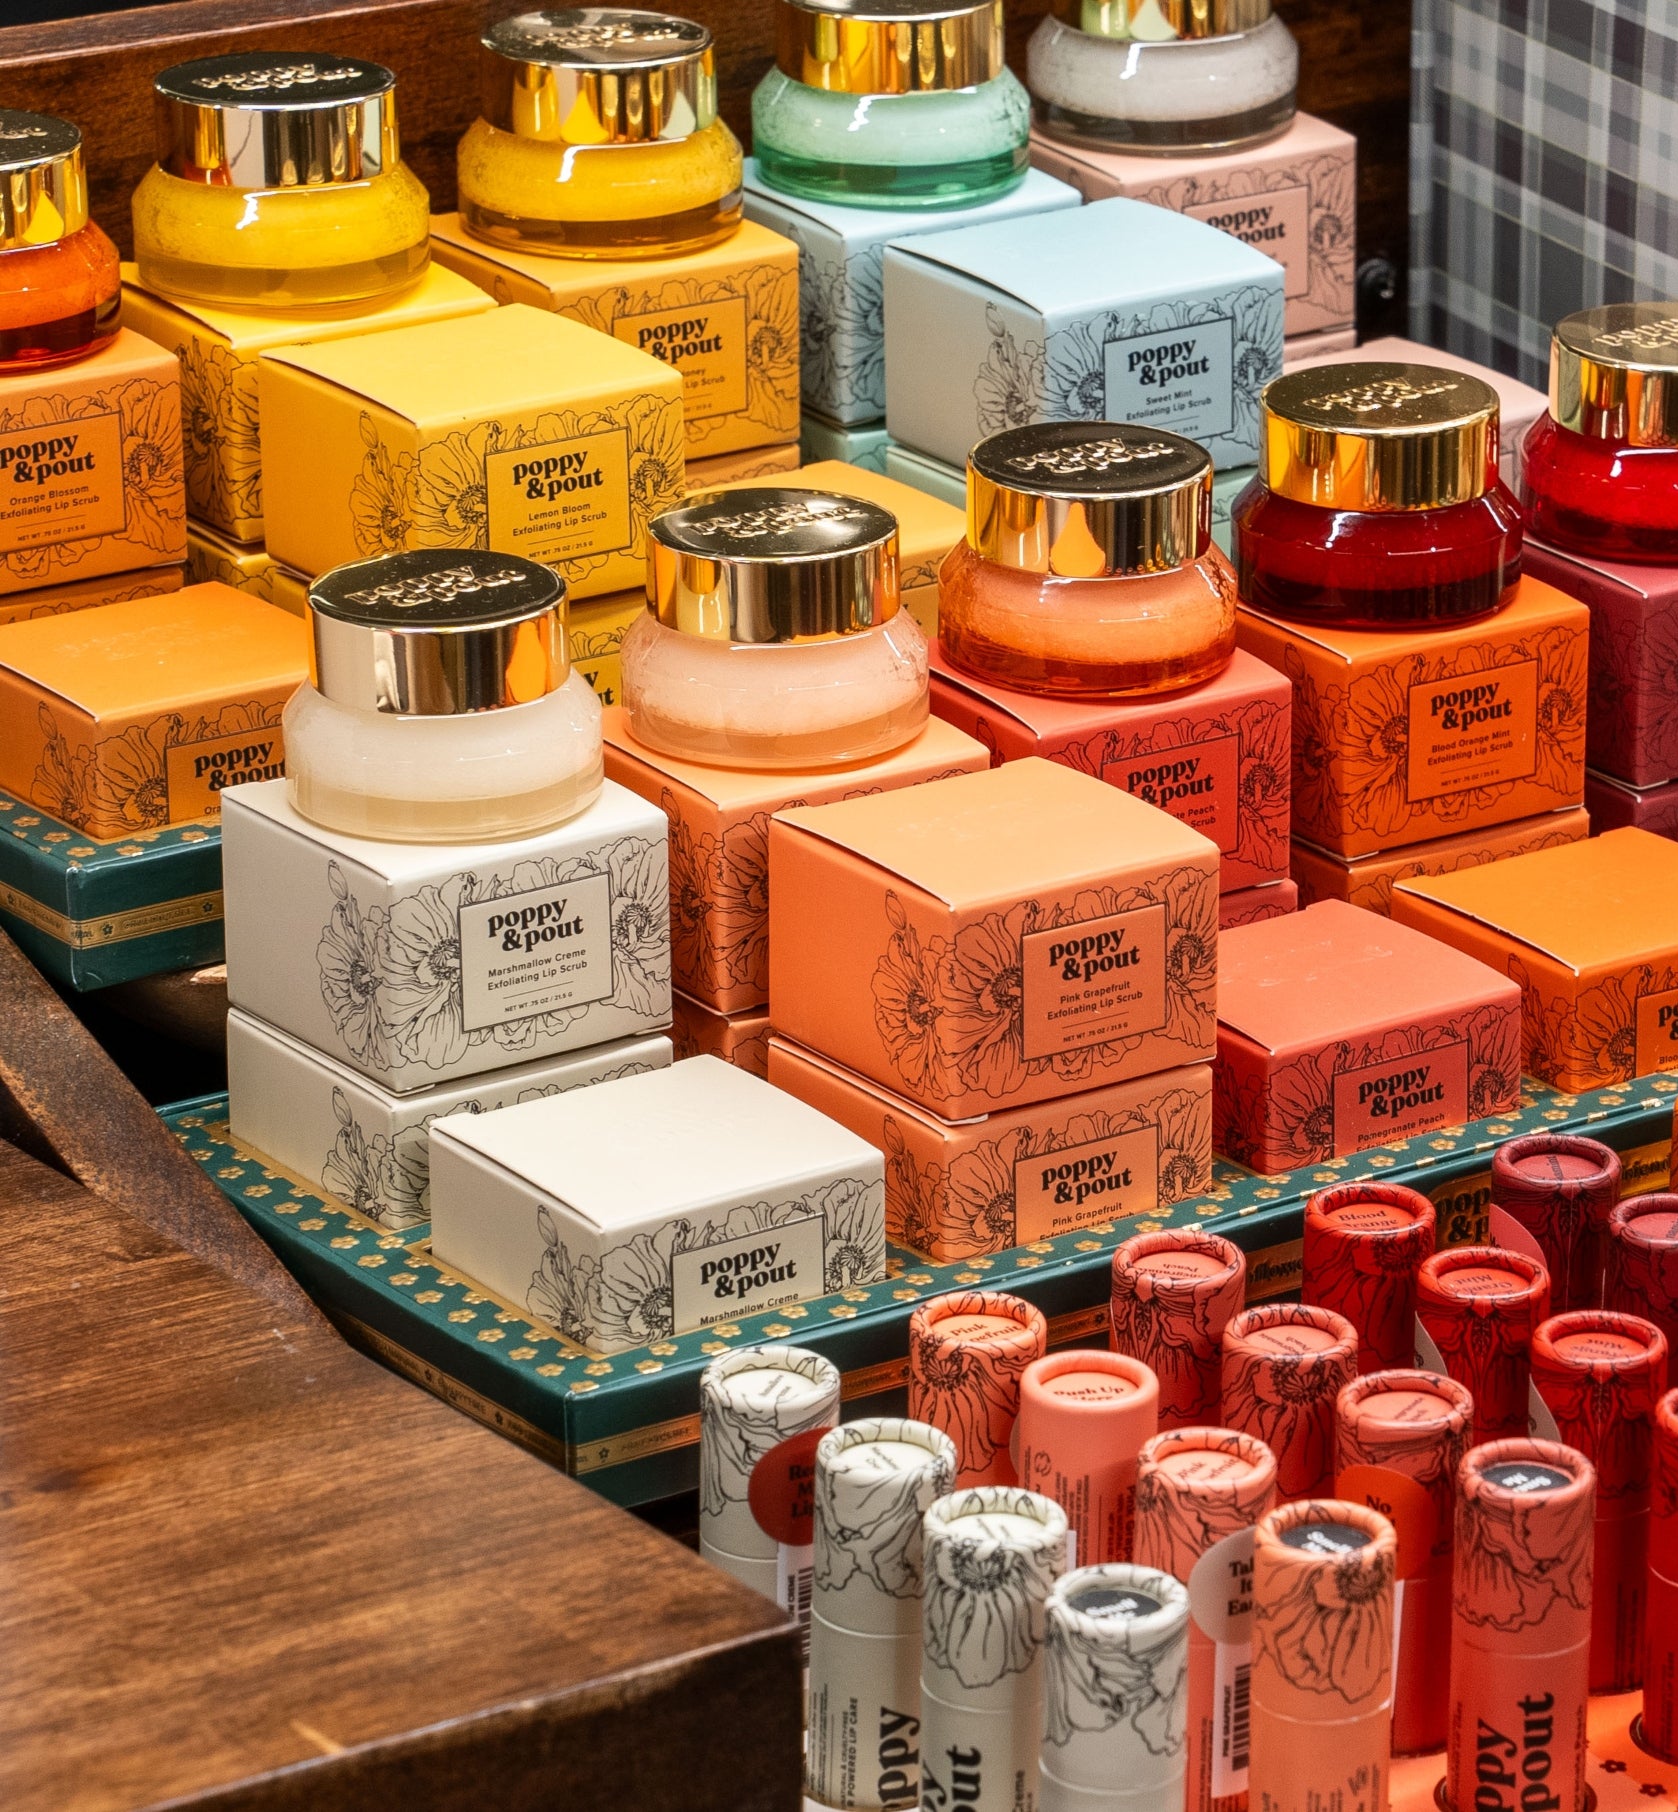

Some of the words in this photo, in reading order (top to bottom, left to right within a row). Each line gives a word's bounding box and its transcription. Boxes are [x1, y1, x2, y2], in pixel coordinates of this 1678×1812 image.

[638, 317, 708, 349] poppy
[1128, 339, 1196, 372] poppy
[1126, 405, 1171, 421] Exfoliating
[1173, 402, 1186, 413] Lip
[1187, 397, 1212, 409] Scrub
[1146, 393, 1173, 406] Sweet
[1174, 389, 1193, 401] Mint
[0, 435, 79, 469] poppy
[512, 451, 588, 485] poppy
[0, 504, 52, 520] Exfoliating
[55, 501, 70, 511] Lip
[72, 495, 100, 507] Scrub
[10, 494, 46, 506] Orange
[49, 485, 89, 498] Blossom
[512, 520, 562, 537] Exfoliating
[565, 516, 579, 528] Lip
[581, 511, 608, 523] Scrub
[528, 509, 559, 522] Lemon
[562, 503, 591, 515] Bloom
[1431, 682, 1500, 717] poppy
[1427, 750, 1473, 766] Exfoliating
[1474, 746, 1488, 756] Lip
[1490, 740, 1514, 752] Scrub
[1432, 741, 1457, 753] Blood
[1458, 734, 1490, 748] Orange
[1492, 730, 1510, 740] Mint
[194, 741, 274, 778] poppy
[1127, 757, 1201, 793] poppy
[1188, 805, 1215, 817] Peach
[1190, 816, 1216, 828] Scrub
[487, 898, 568, 939] poppy
[1048, 928, 1126, 967] poppy
[487, 972, 540, 991] Exfoliating
[542, 967, 557, 978] Lip
[560, 960, 588, 973] Scrub
[488, 957, 552, 978] Marshmallow
[554, 948, 587, 962] Creme
[1047, 1004, 1097, 1021] Exfoliating
[1099, 998, 1114, 1009] Lip
[1117, 991, 1143, 1004] Scrub
[1060, 993, 1080, 1004] Pink
[1083, 981, 1130, 999] Grapefruit
[1358, 1065, 1431, 1104] poppy
[1357, 1121, 1416, 1143] Pomegranate
[1418, 1113, 1445, 1127] Peach
[1041, 1151, 1118, 1191] poppy
[1052, 1215, 1072, 1227] Pink
[1075, 1202, 1122, 1221] Grapefruit
[1338, 1209, 1387, 1222] Blood
[700, 1243, 781, 1285] poppy
[700, 1302, 764, 1325] Marshmallow
[767, 1293, 799, 1307] Creme
[951, 1322, 988, 1338] Pink
[1100, 1386, 1124, 1397] Up
[1365, 1494, 1392, 1514] No
[850, 1697, 859, 1725] CARE
[848, 1727, 858, 1744] LIP
[1222, 1739, 1230, 1757] PINK
[846, 1746, 856, 1798] POWERED
[878, 1706, 921, 1811] ppy
[1474, 1718, 1518, 1811] ppy
